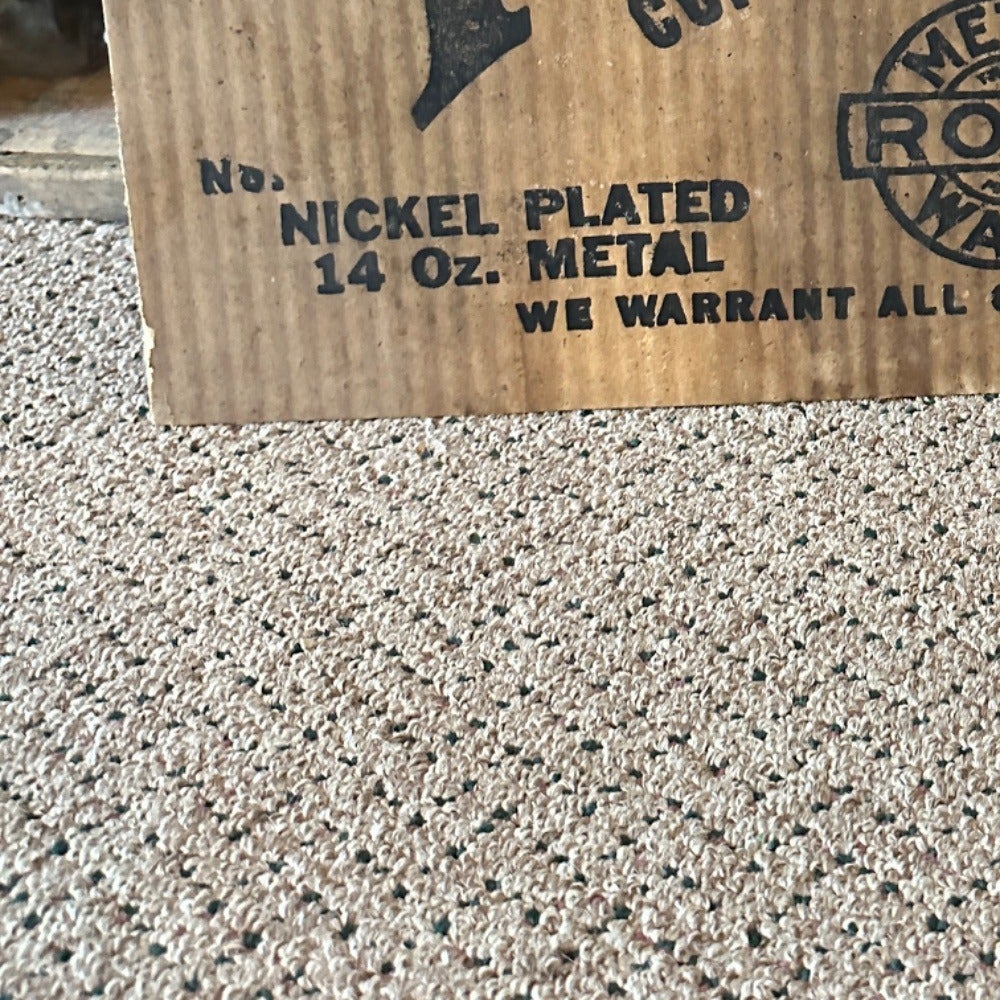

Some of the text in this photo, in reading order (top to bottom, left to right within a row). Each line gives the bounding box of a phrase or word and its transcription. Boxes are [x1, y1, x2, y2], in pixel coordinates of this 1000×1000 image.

[279, 179, 750, 245] NICKEL PLATED
[315, 231, 724, 294] 14 Oz. METAL
[515, 298, 593, 333] WE
[615, 287, 855, 328] WARRANT
[878, 284, 967, 319] ALL
